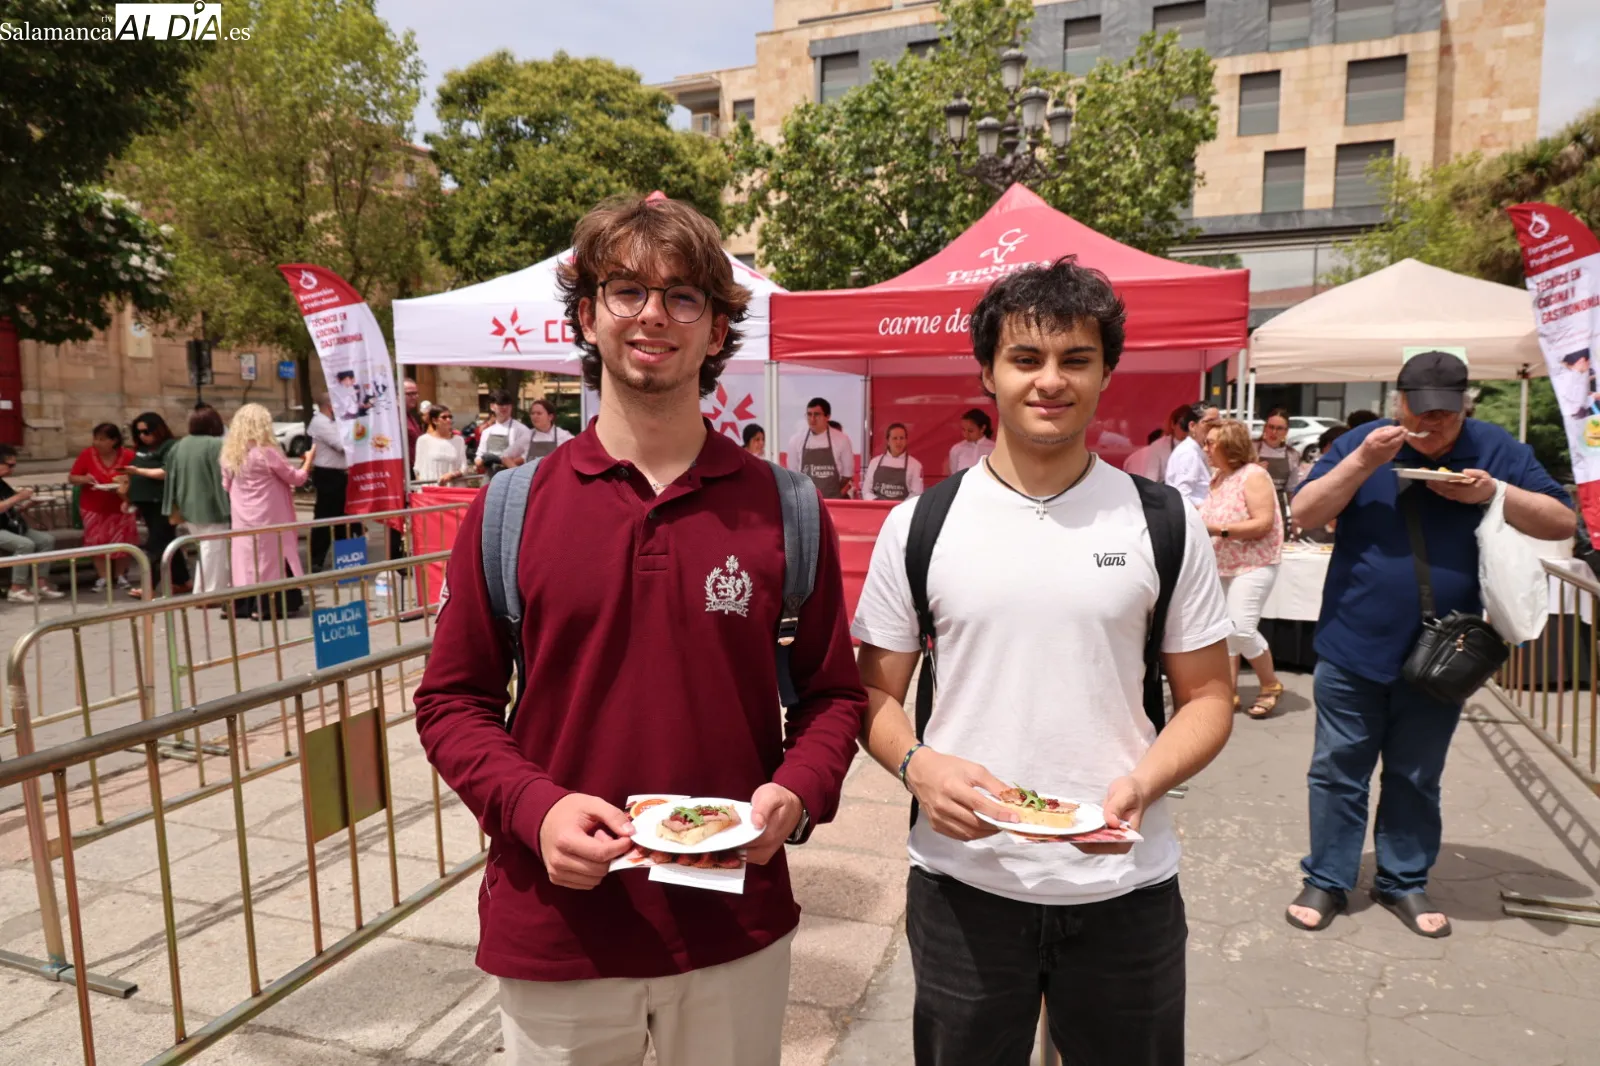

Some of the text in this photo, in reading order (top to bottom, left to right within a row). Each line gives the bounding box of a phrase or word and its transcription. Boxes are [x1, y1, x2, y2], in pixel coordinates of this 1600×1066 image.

[878, 308, 970, 335] carne de
[1093, 552, 1127, 568] Vans
[322, 624, 361, 643] LOCAL
